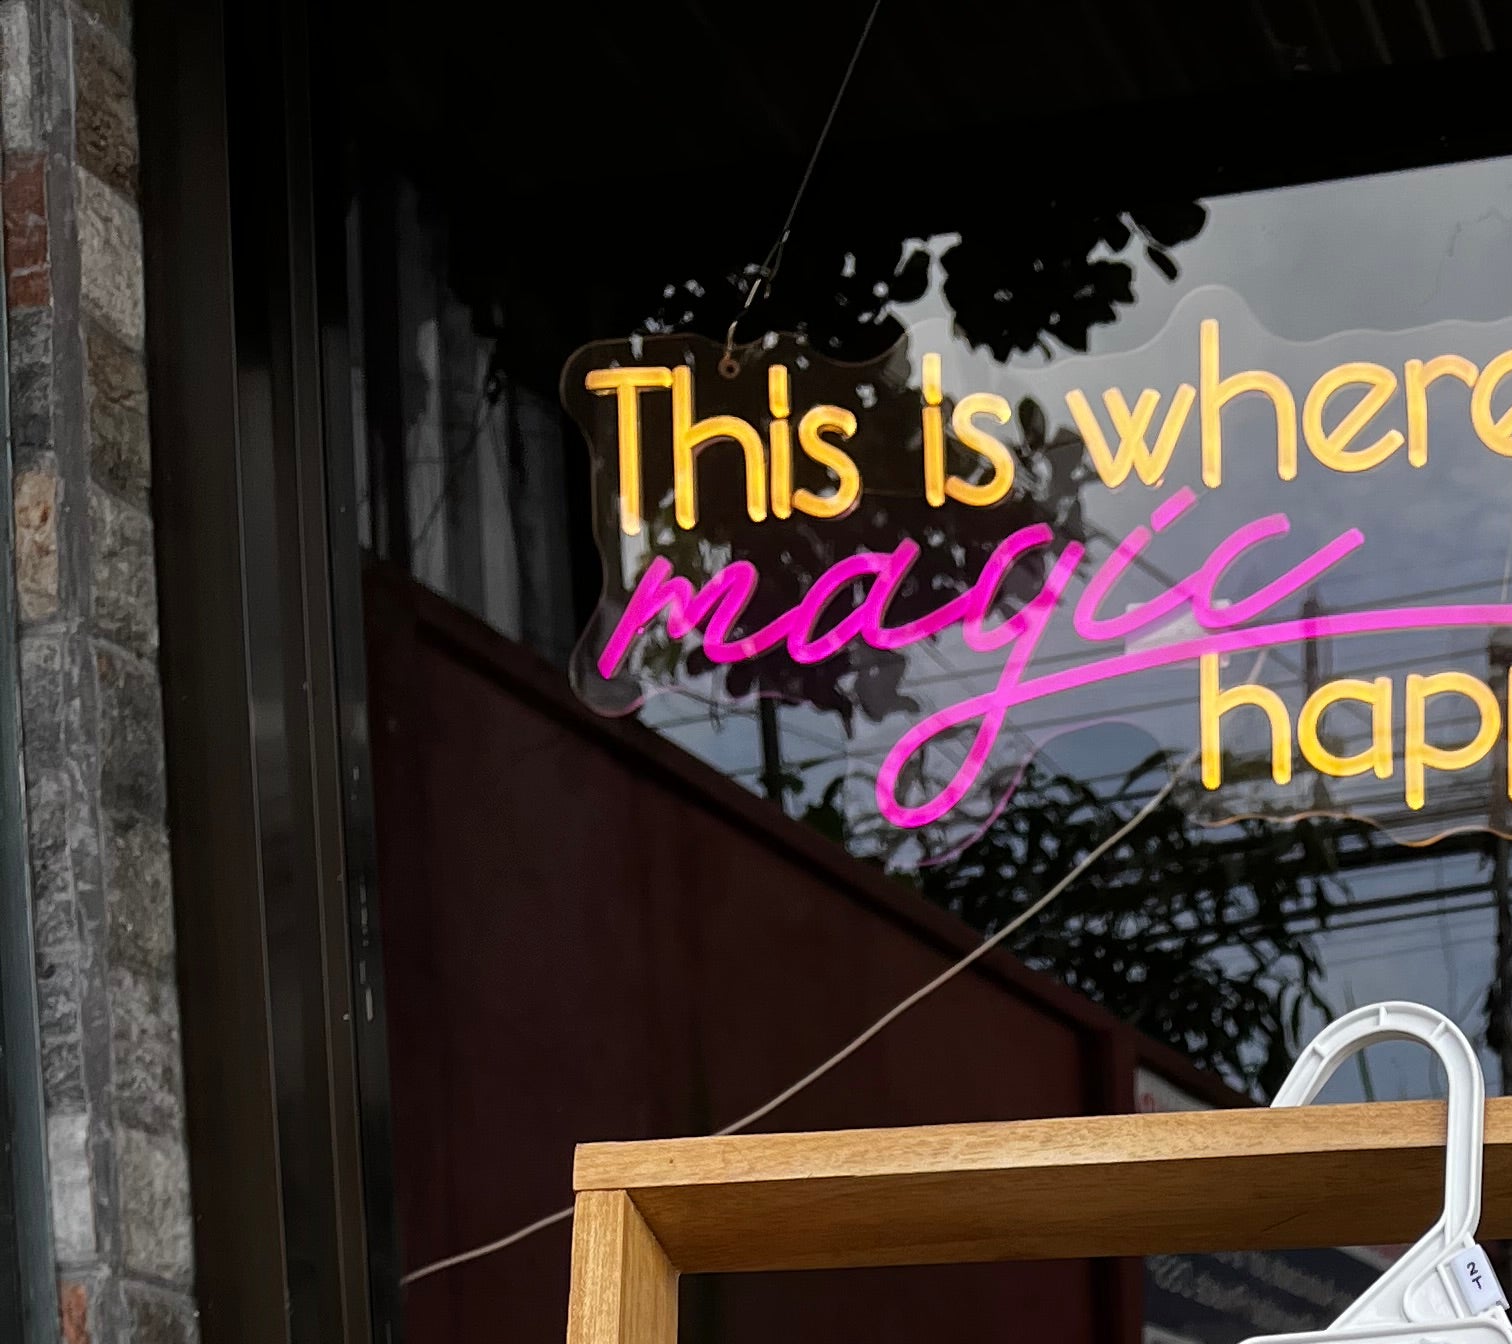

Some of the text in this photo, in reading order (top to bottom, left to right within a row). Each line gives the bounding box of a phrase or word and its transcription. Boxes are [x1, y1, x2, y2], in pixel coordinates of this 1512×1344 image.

[586, 363, 860, 532] This
[922, 355, 1016, 508] is
[1466, 1261, 1483, 1291] 2T
